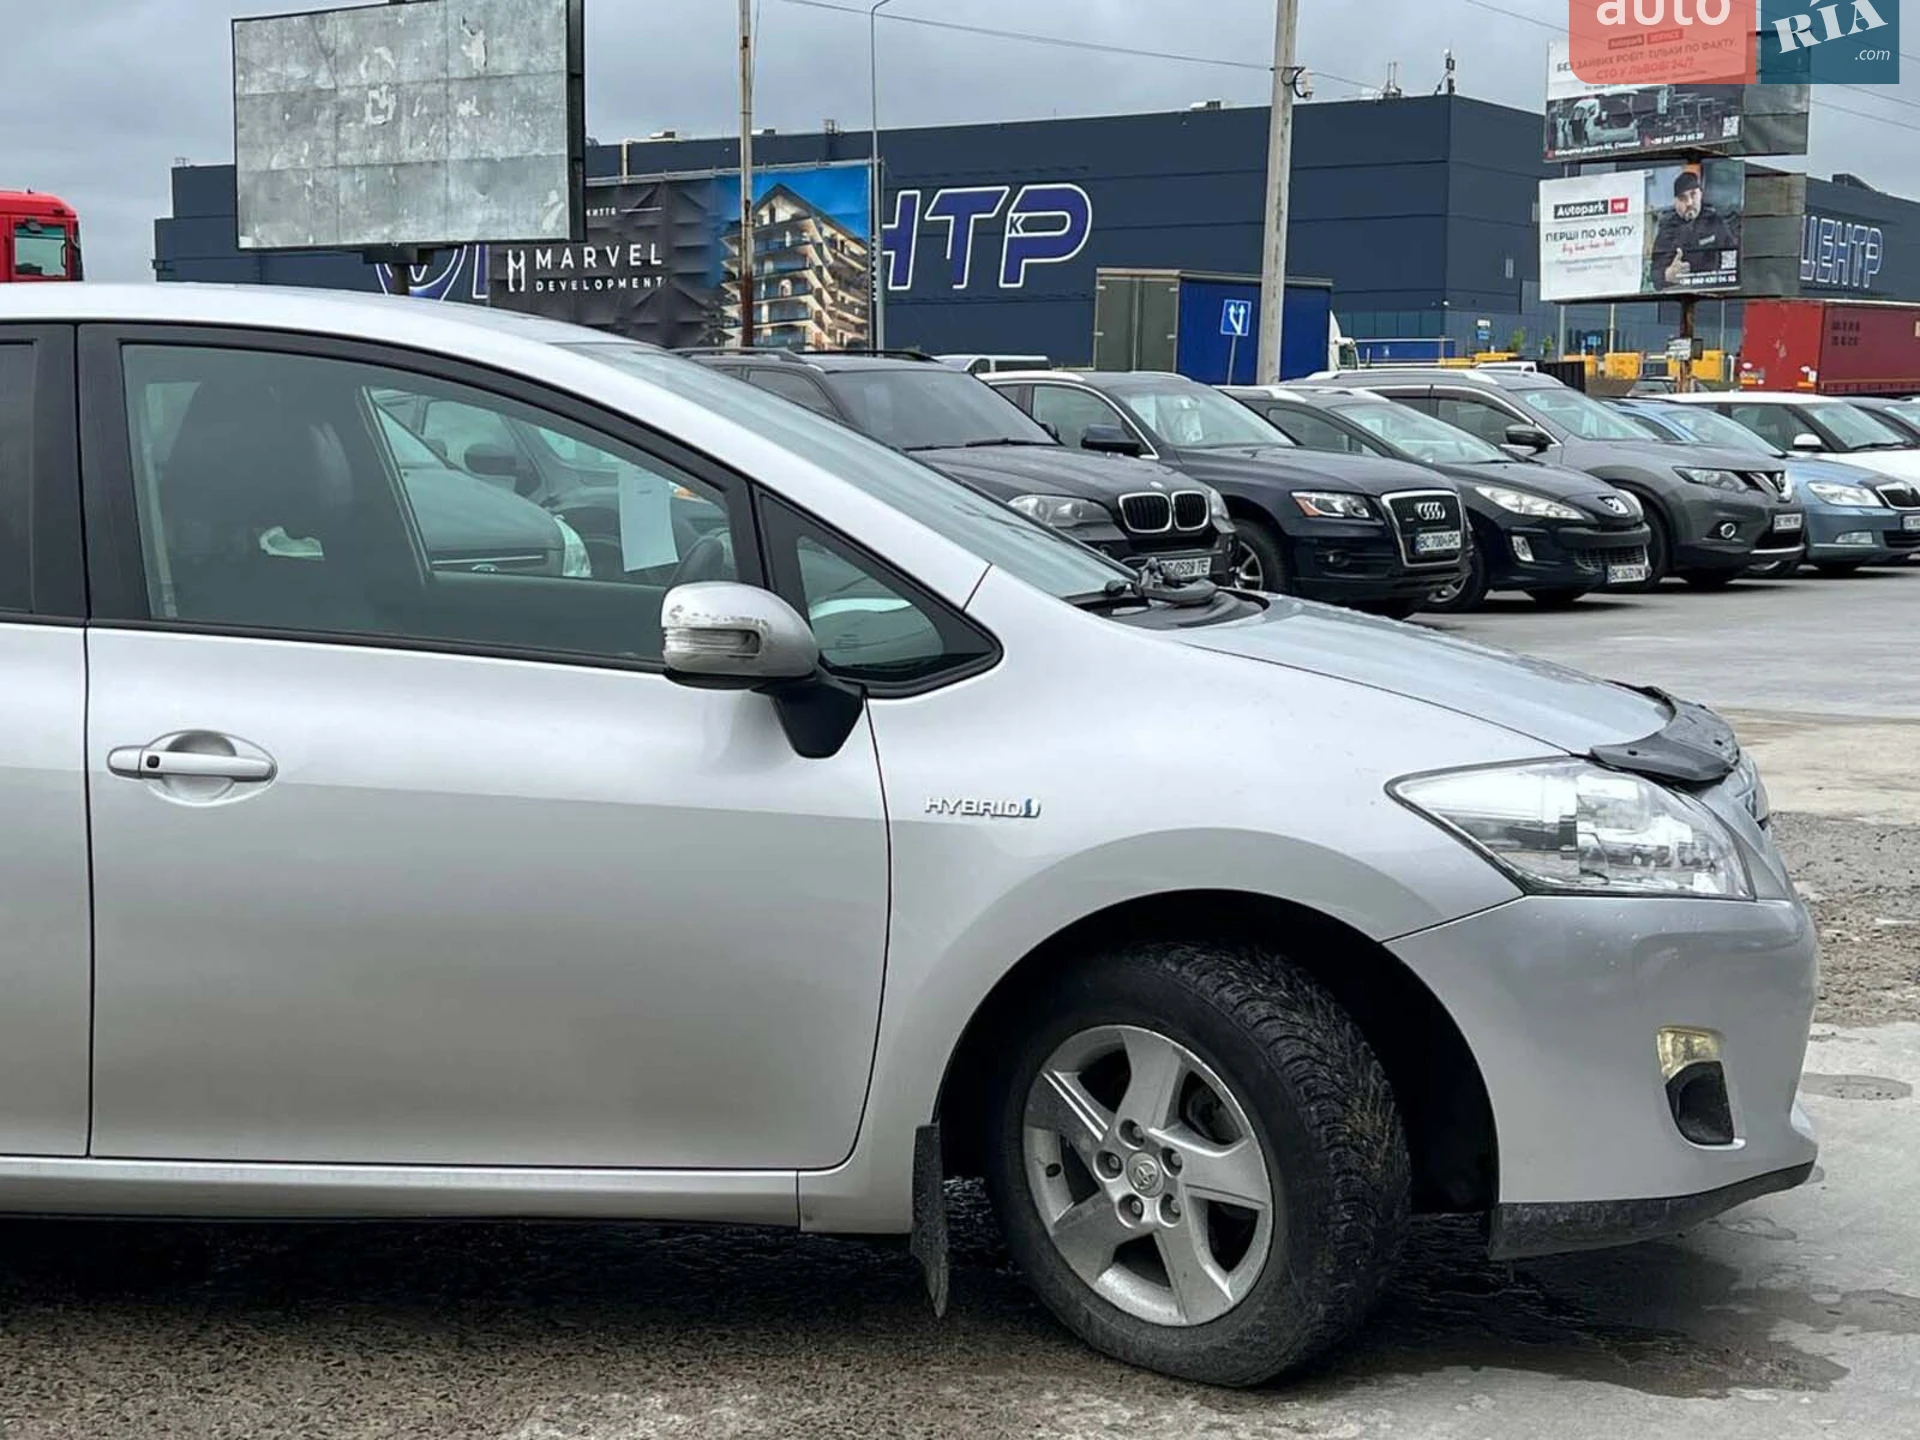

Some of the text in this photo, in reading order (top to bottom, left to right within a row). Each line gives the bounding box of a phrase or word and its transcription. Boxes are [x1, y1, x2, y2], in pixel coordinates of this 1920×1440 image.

[1556, 201, 1606, 217] Autopark
[1545, 230, 1579, 242] ПЕРШІ
[1581, 228, 1597, 239] ПО
[535, 242, 663, 270] MARVEL
[535, 276, 664, 293] DEVELOPMENT
[925, 797, 1021, 817] HYBRID
